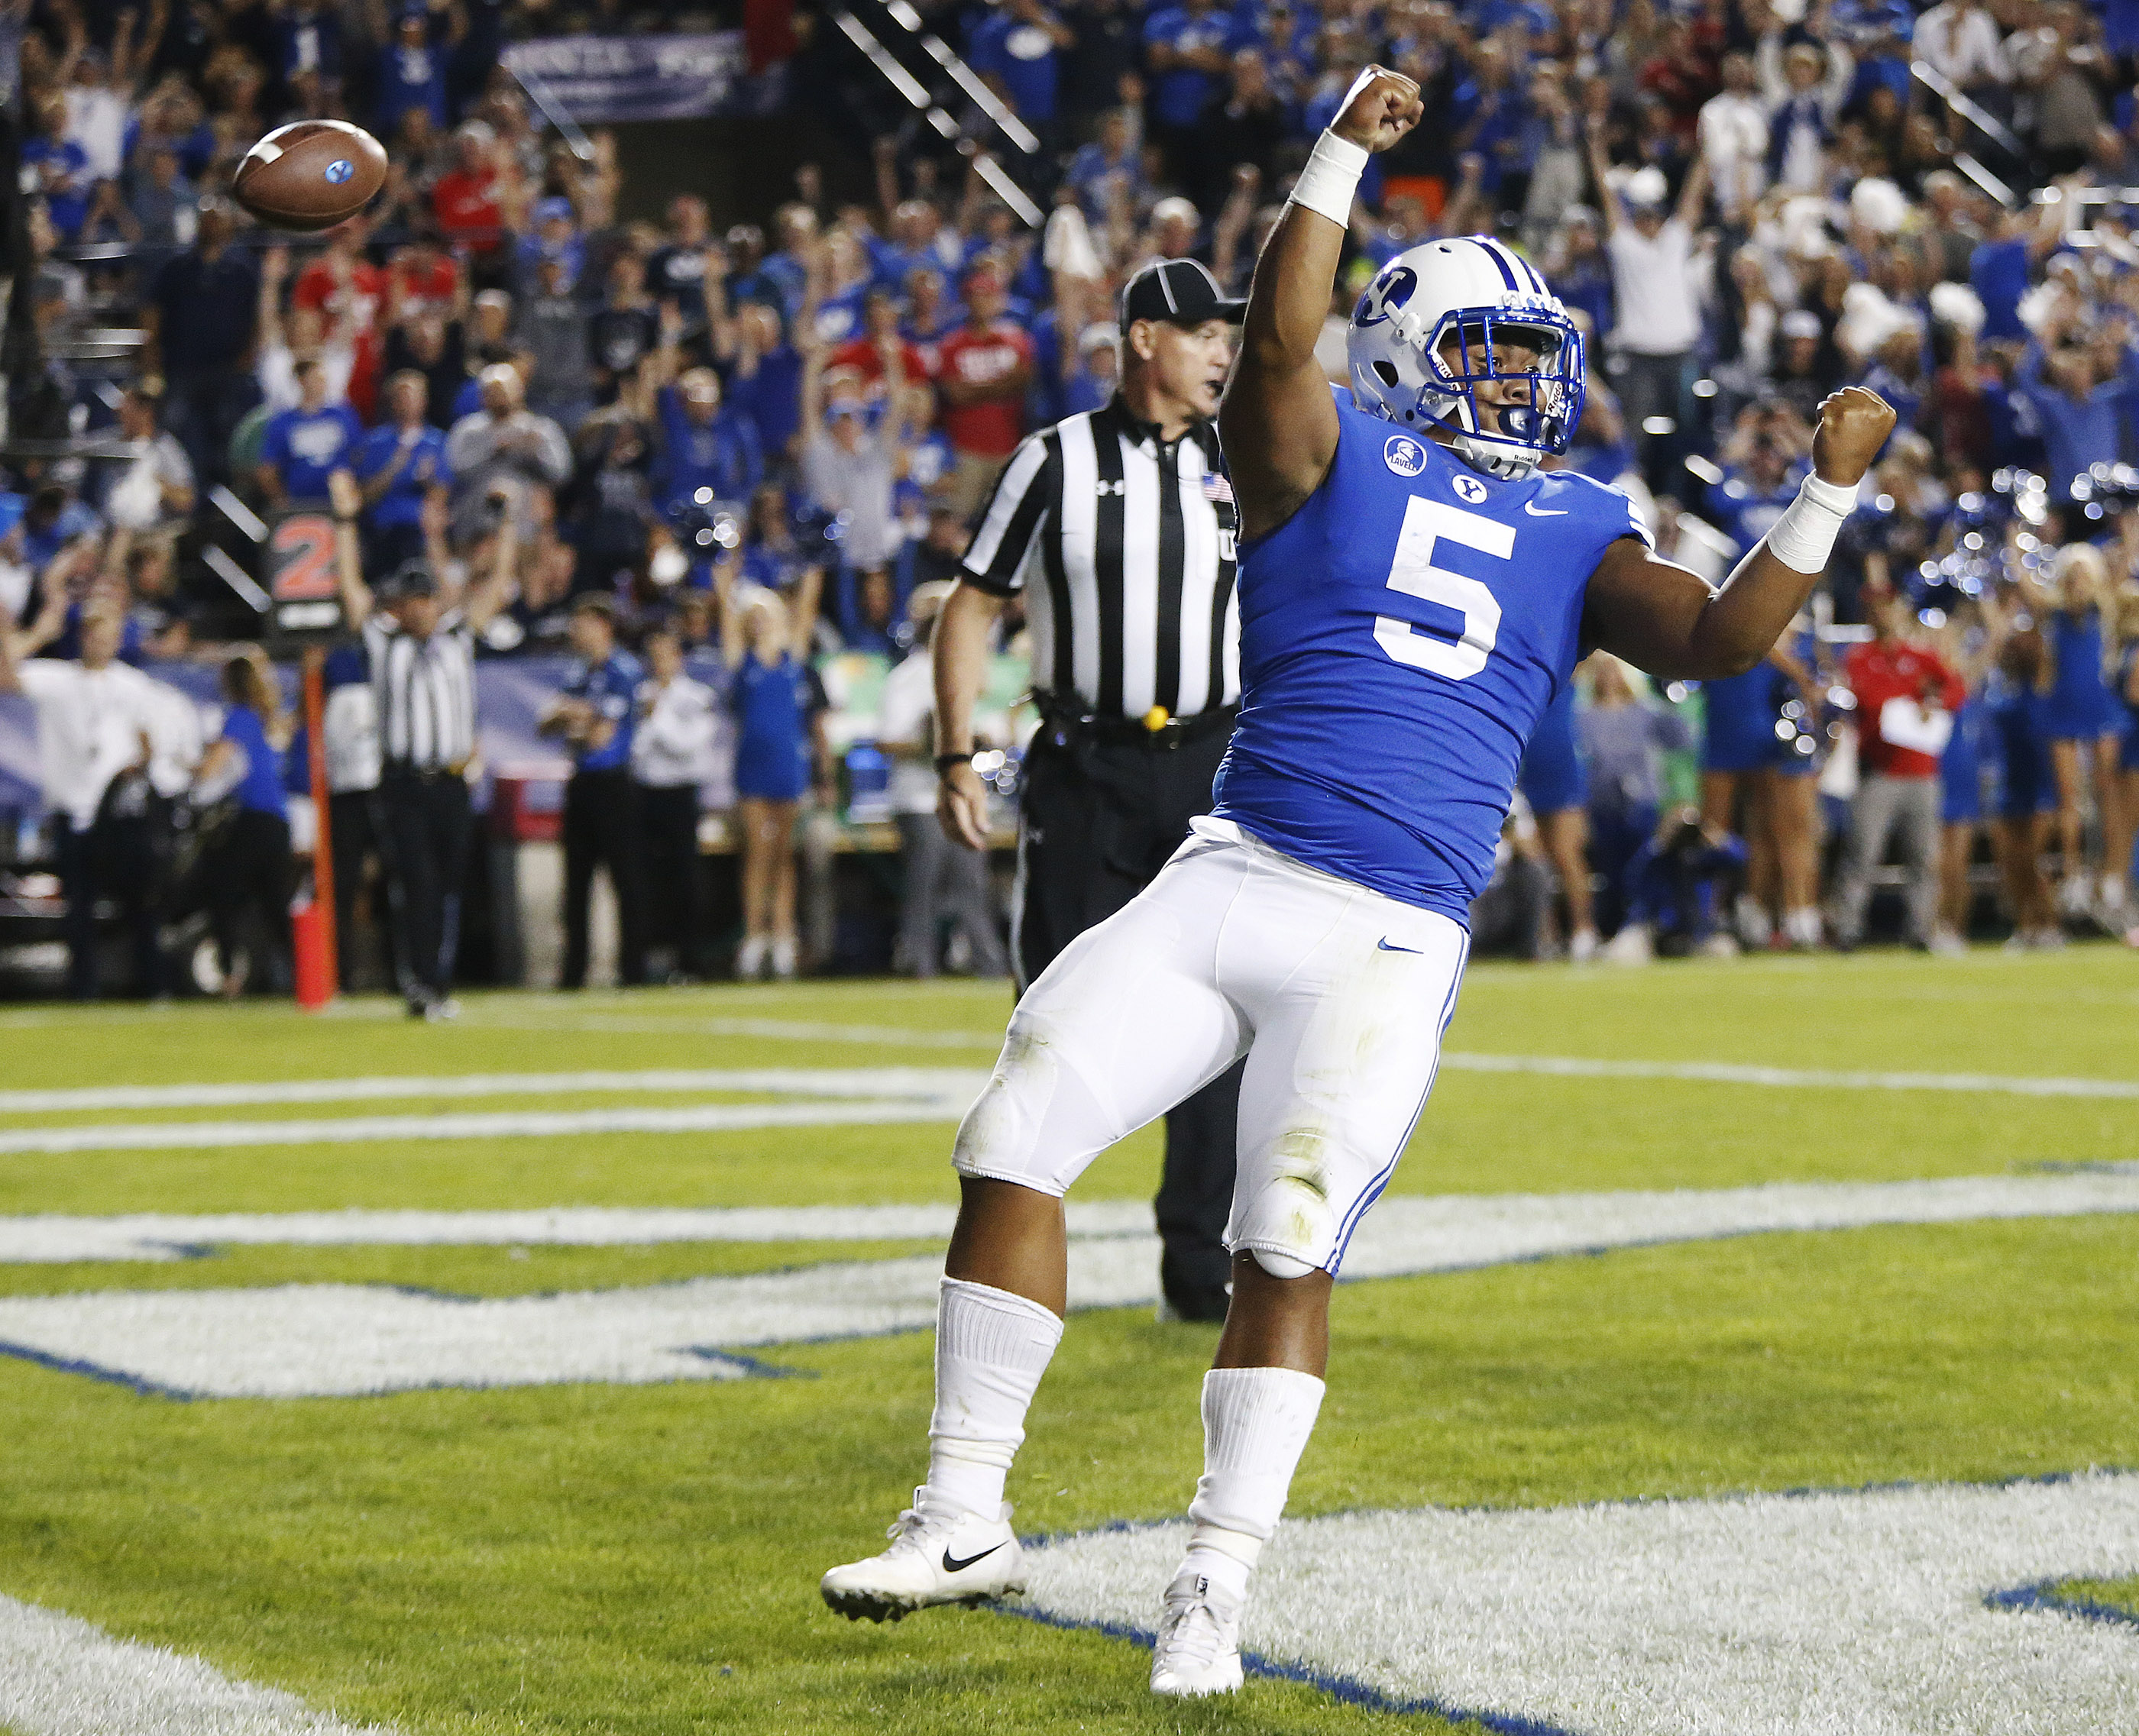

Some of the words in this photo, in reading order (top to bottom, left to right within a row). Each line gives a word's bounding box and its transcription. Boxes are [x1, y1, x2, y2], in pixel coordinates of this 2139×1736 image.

[1461, 479, 1482, 499] Y
[271, 513, 341, 602] 2
[1373, 494, 1517, 681] 5
